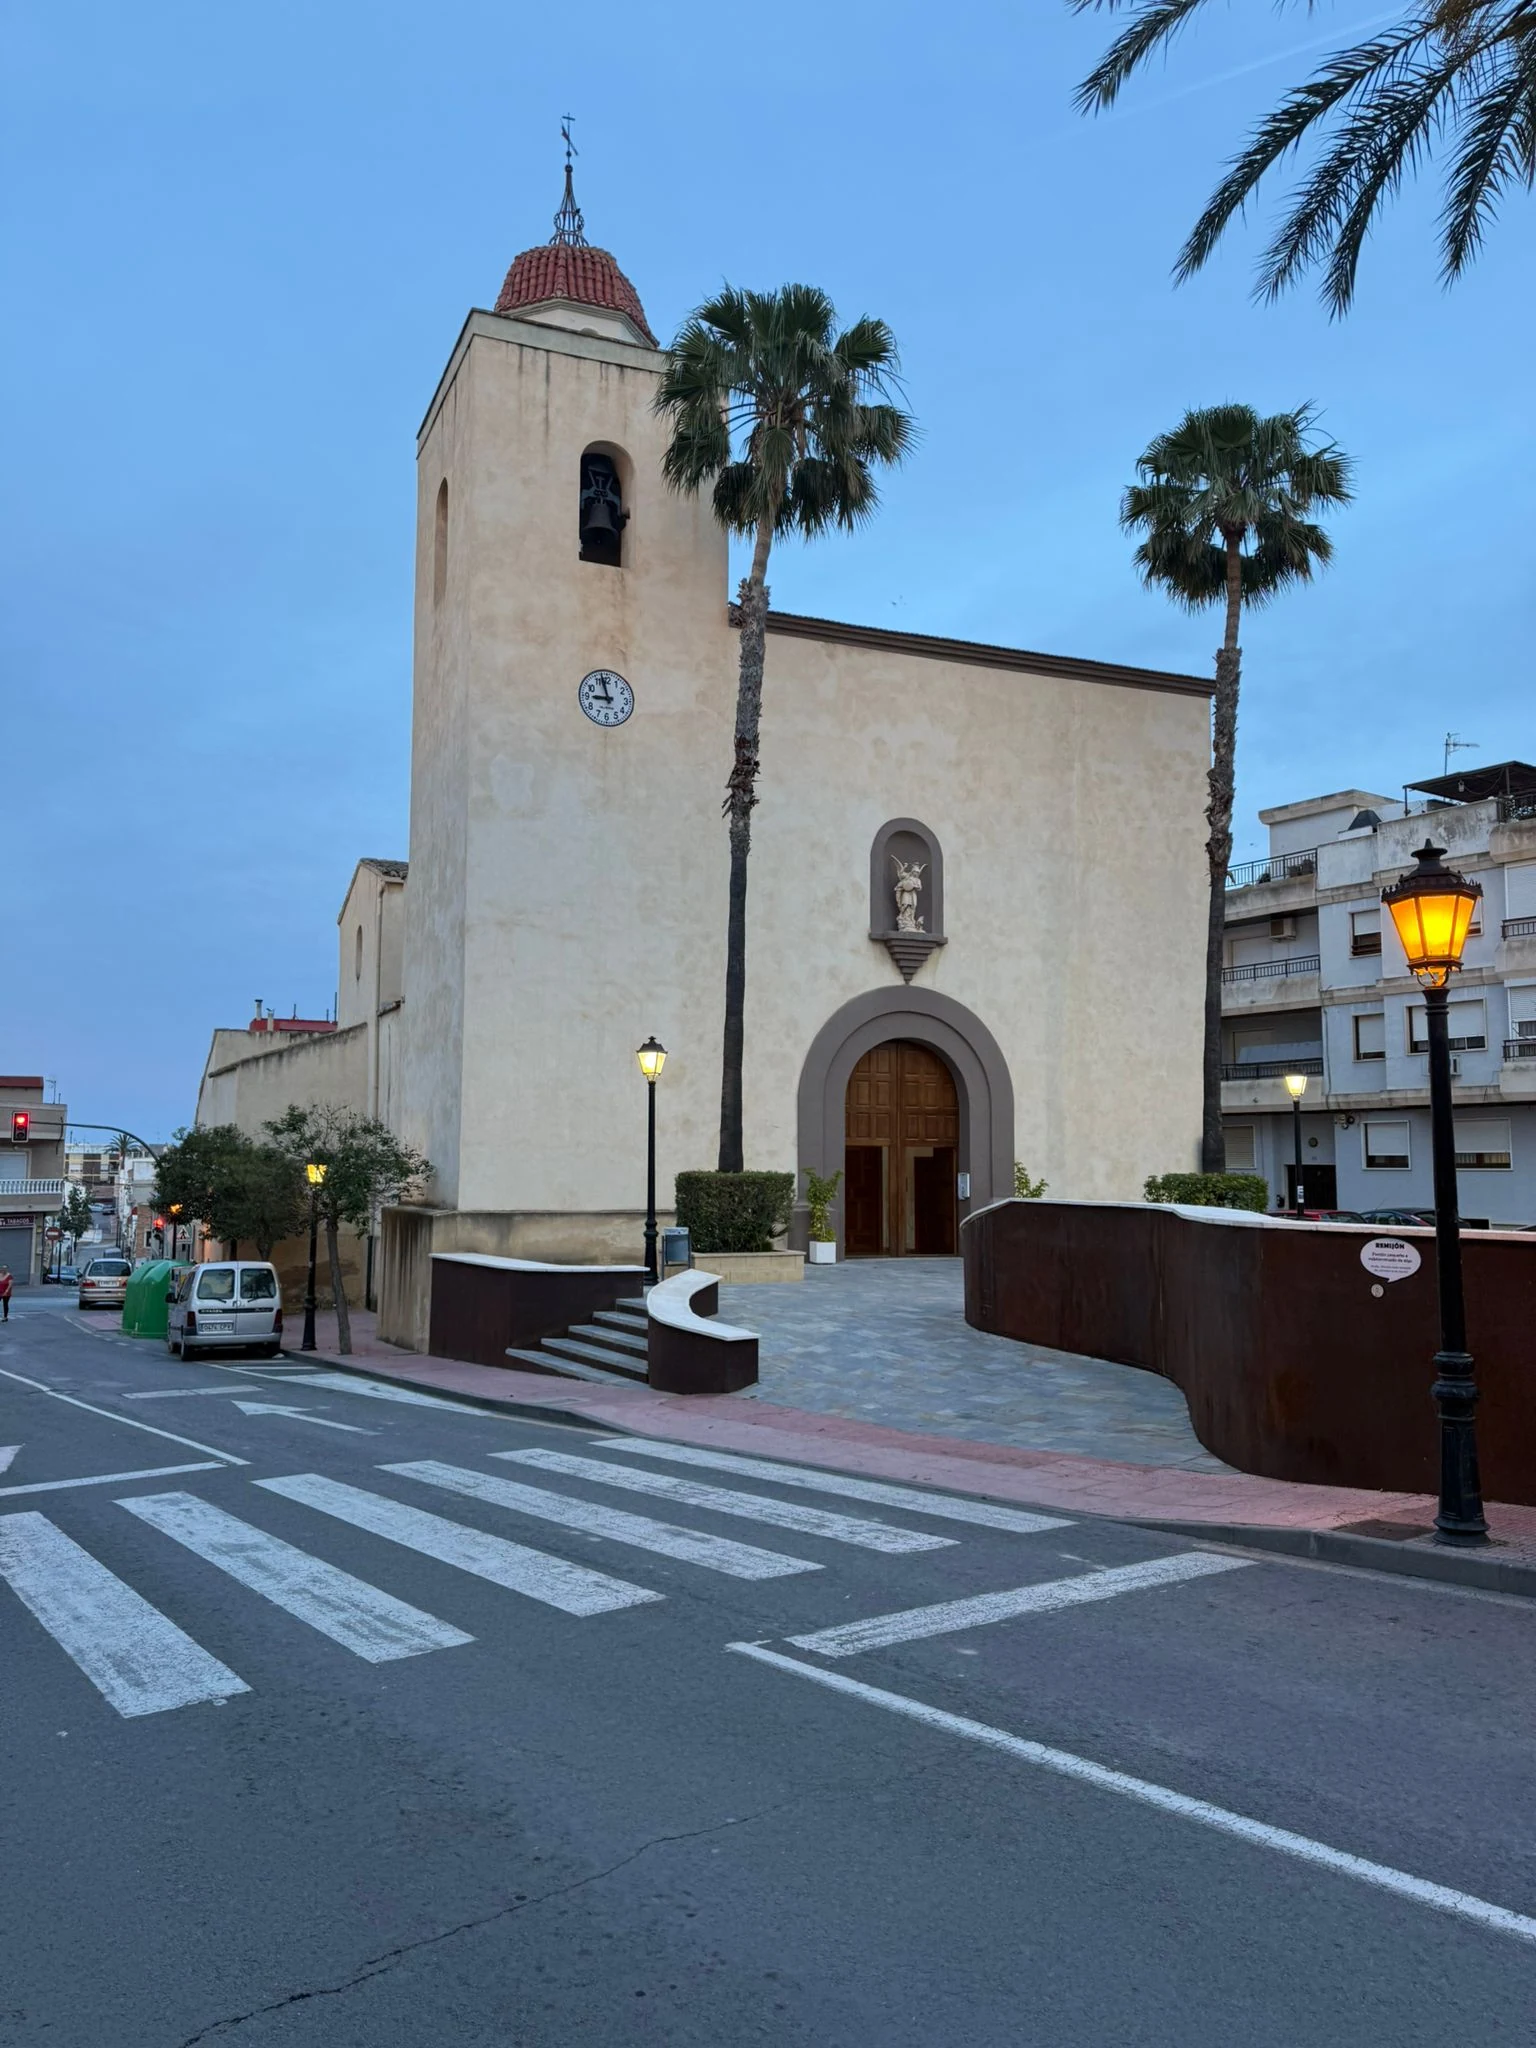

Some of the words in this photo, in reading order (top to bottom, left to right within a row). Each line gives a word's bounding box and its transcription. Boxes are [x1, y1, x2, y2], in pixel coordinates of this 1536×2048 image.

[588, 684, 595, 692] 10
[614, 680, 618, 688] 1
[620, 687, 625, 695] 2
[585, 692, 590, 700] 9
[588, 702, 593, 710] 8
[624, 698, 629, 706] 3
[604, 712, 609, 720] 6
[614, 712, 619, 720] 5
